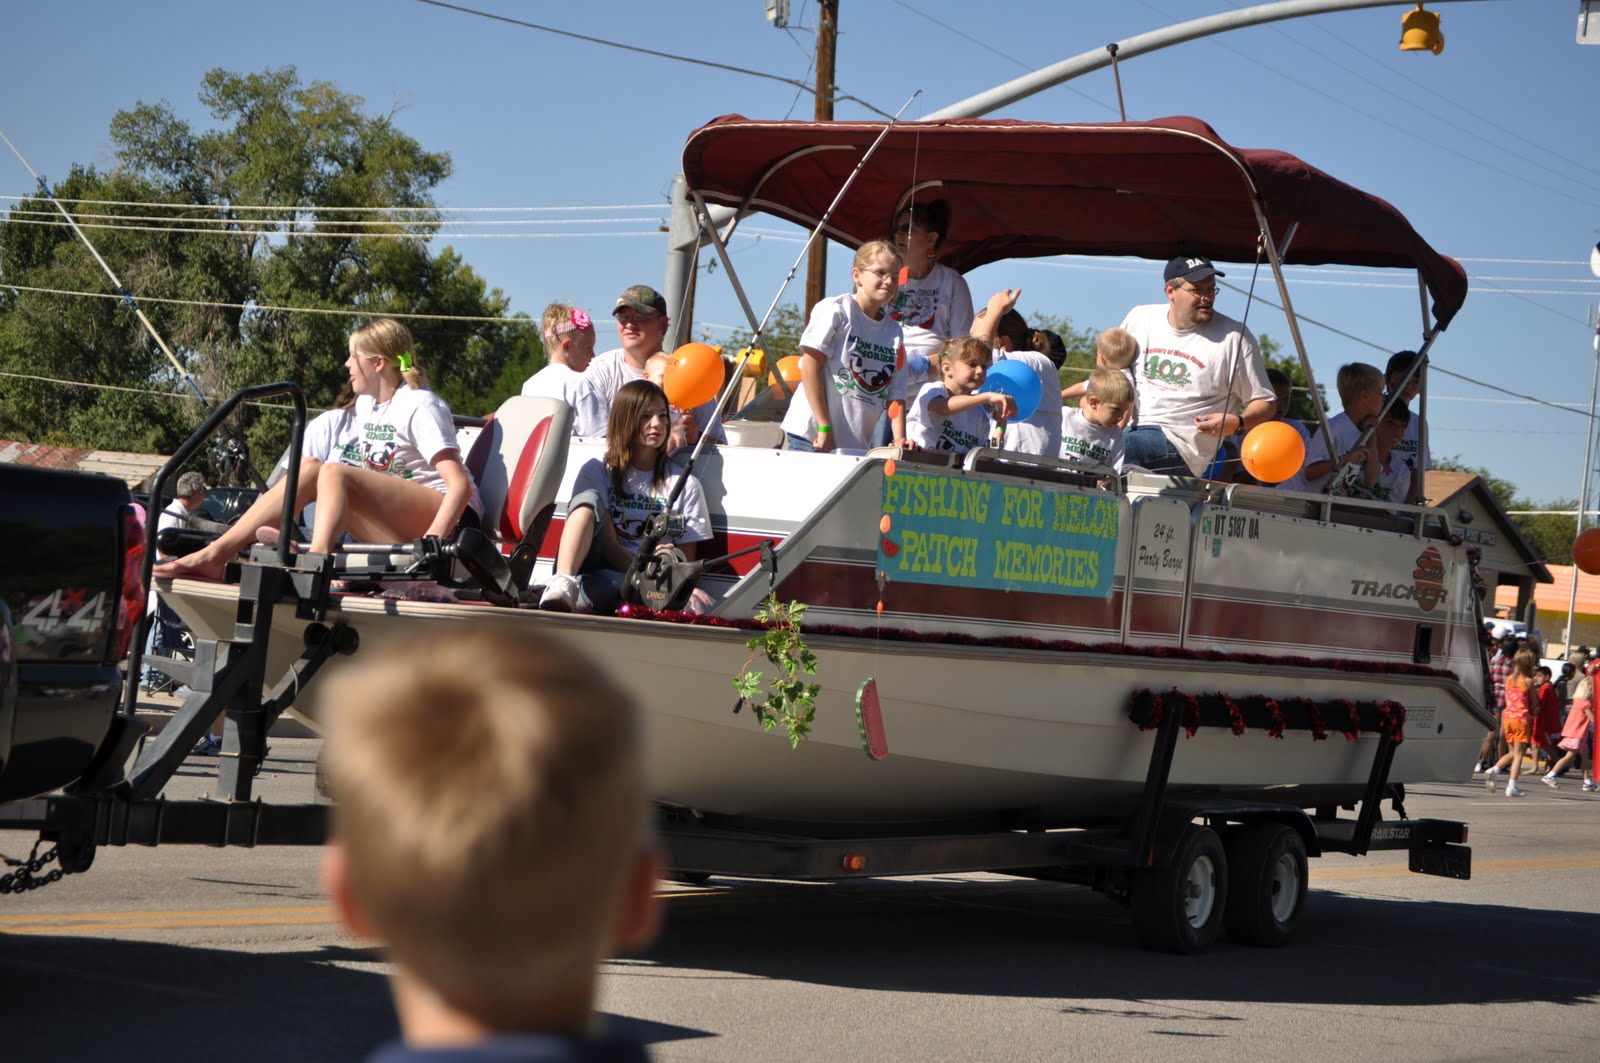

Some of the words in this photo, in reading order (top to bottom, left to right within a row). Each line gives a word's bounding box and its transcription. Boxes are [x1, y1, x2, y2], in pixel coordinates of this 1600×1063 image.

[1061, 436, 1091, 449] MELON
[1092, 444, 1111, 456] PATC
[1066, 444, 1101, 461] MEMORI
[883, 473, 991, 524] FISHING
[1001, 487, 1043, 529] FOR
[1052, 493, 1119, 540] MELON
[1153, 523, 1166, 539] 24
[1214, 514, 1226, 535] UT
[1228, 516, 1246, 538] 5187
[1249, 518, 1259, 539] UA
[899, 531, 979, 578] PATCH
[993, 540, 1100, 589] MEMORIES
[1138, 545, 1160, 573] Party
[1162, 548, 1184, 575] Barge
[1351, 580, 1448, 603] TRACKER
[1370, 827, 1410, 840] RAILSTAR
